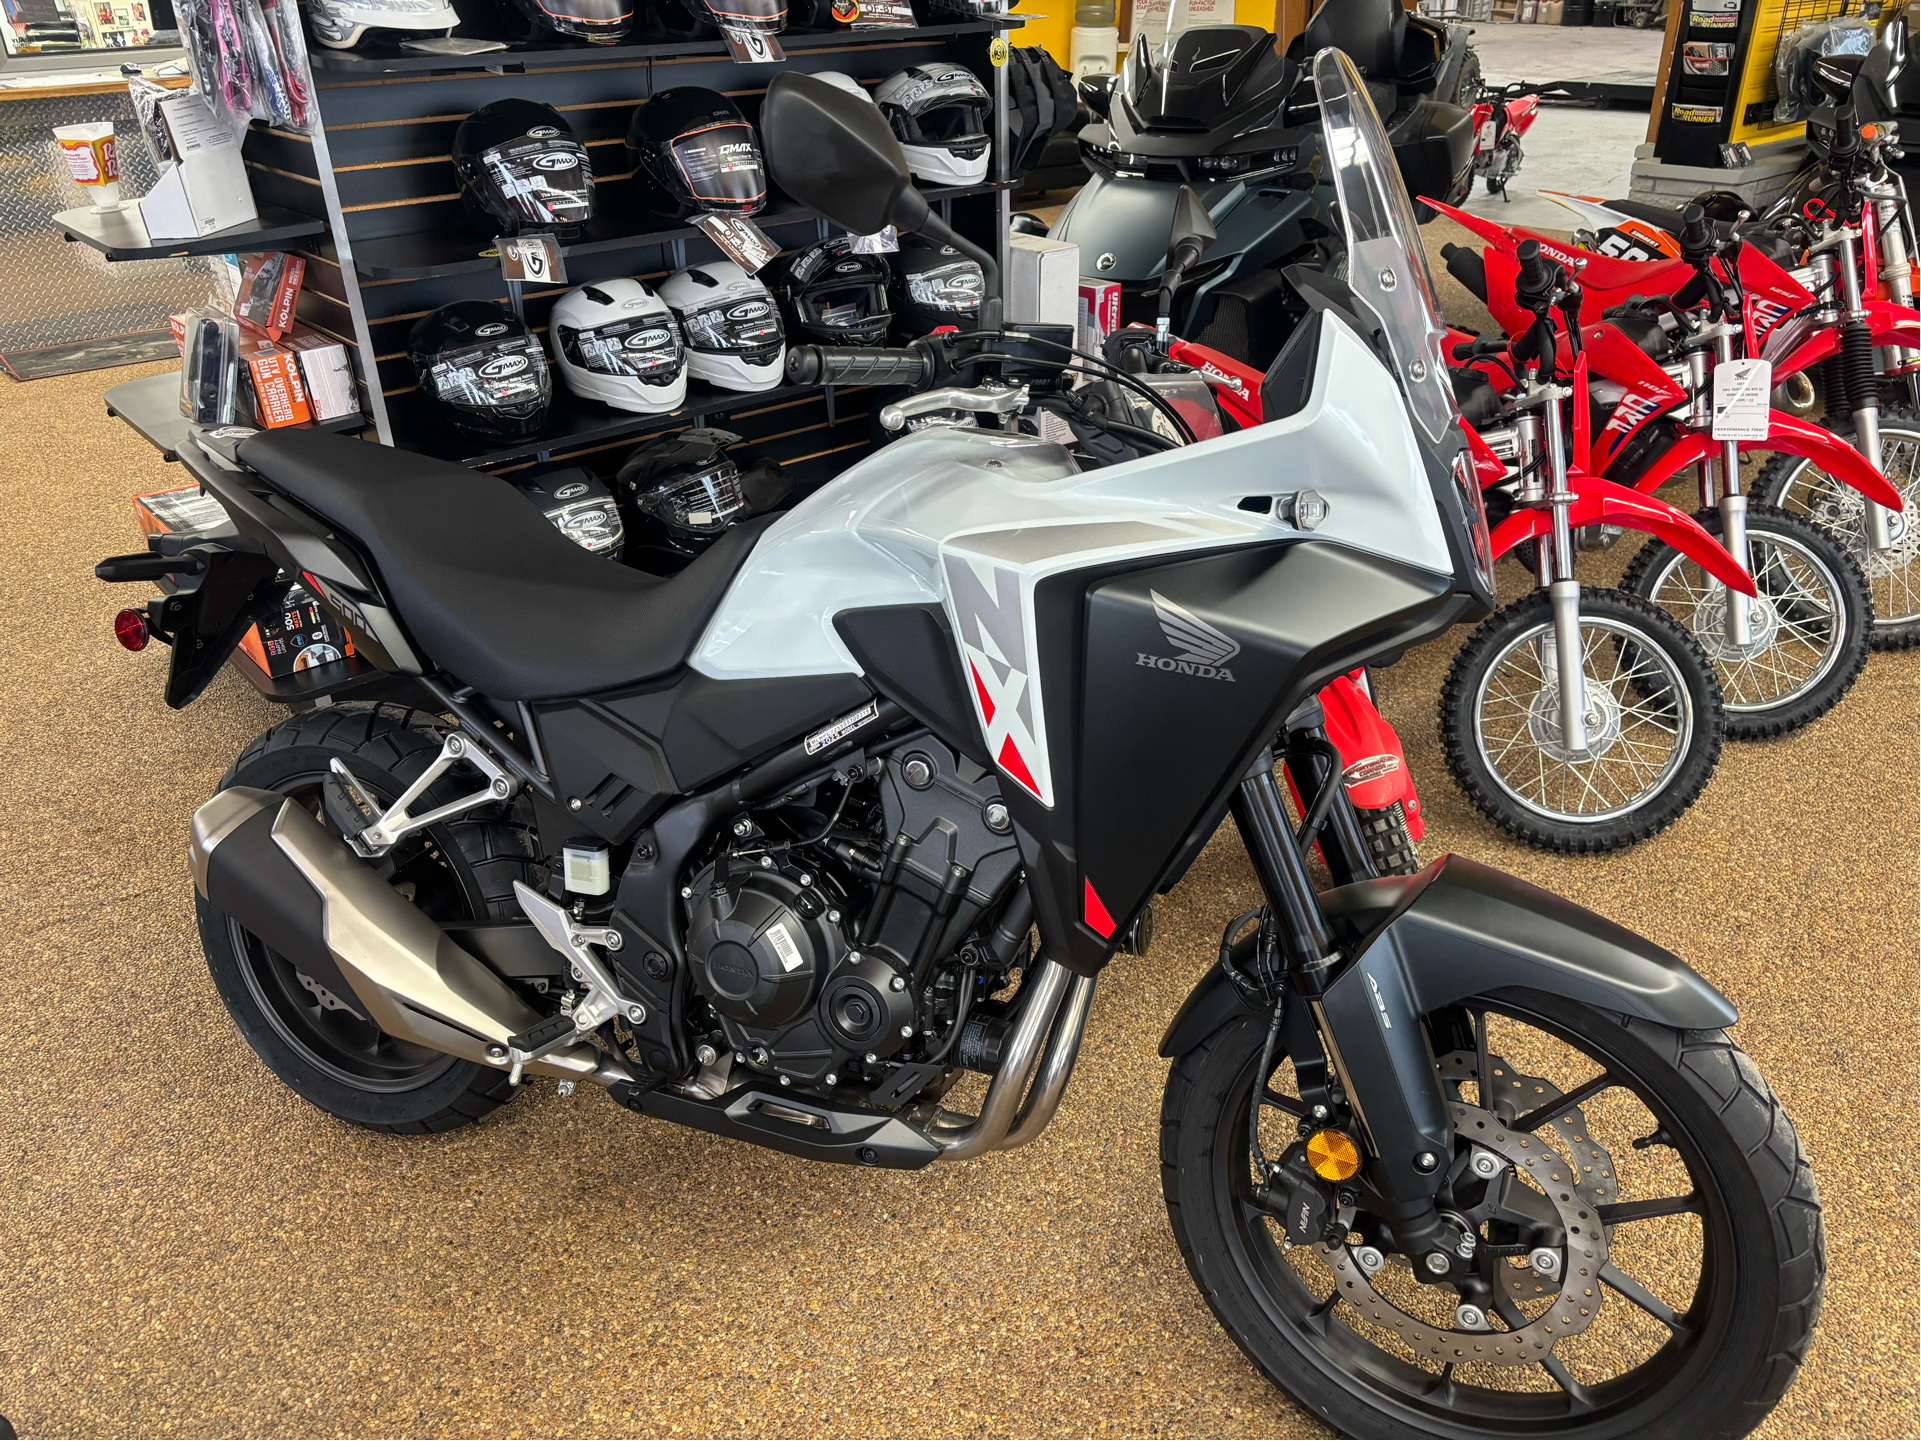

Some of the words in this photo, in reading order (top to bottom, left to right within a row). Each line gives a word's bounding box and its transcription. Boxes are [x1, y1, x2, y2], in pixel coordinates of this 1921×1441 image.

[936, 71, 973, 82] GMAX
[1674, 107, 1695, 116] Road
[1683, 115, 1715, 123] RUNNER
[528, 126, 559, 138] GMAX
[718, 143, 752, 155] GMAX
[534, 153, 577, 170] GMAX
[731, 219, 761, 248] GMAX
[1539, 241, 1575, 267] ONDA
[836, 262, 862, 272] GMAX
[726, 282, 752, 291] GMAX
[947, 274, 980, 288] GMAX
[278, 288, 293, 328] KOLPIN
[621, 299, 649, 309] GMAX
[728, 302, 768, 320] GMAX
[476, 323, 508, 336] GMAX
[626, 330, 669, 348] GMAX
[268, 357, 281, 374] UTV
[480, 356, 527, 377] GMAX
[284, 354, 304, 403] KOLPIN
[258, 359, 272, 379] GUN
[265, 382, 285, 423] CARRIER
[274, 377, 294, 420] OVERHEAD
[555, 483, 588, 497] GMAX
[562, 511, 606, 531] GMAX
[267, 640, 277, 656] RGB
[1135, 652, 1236, 682] HONDA
[713, 962, 754, 978] HONDA
[1366, 971, 1392, 1029] ABS
[1299, 1201, 1311, 1234] NISSIN
